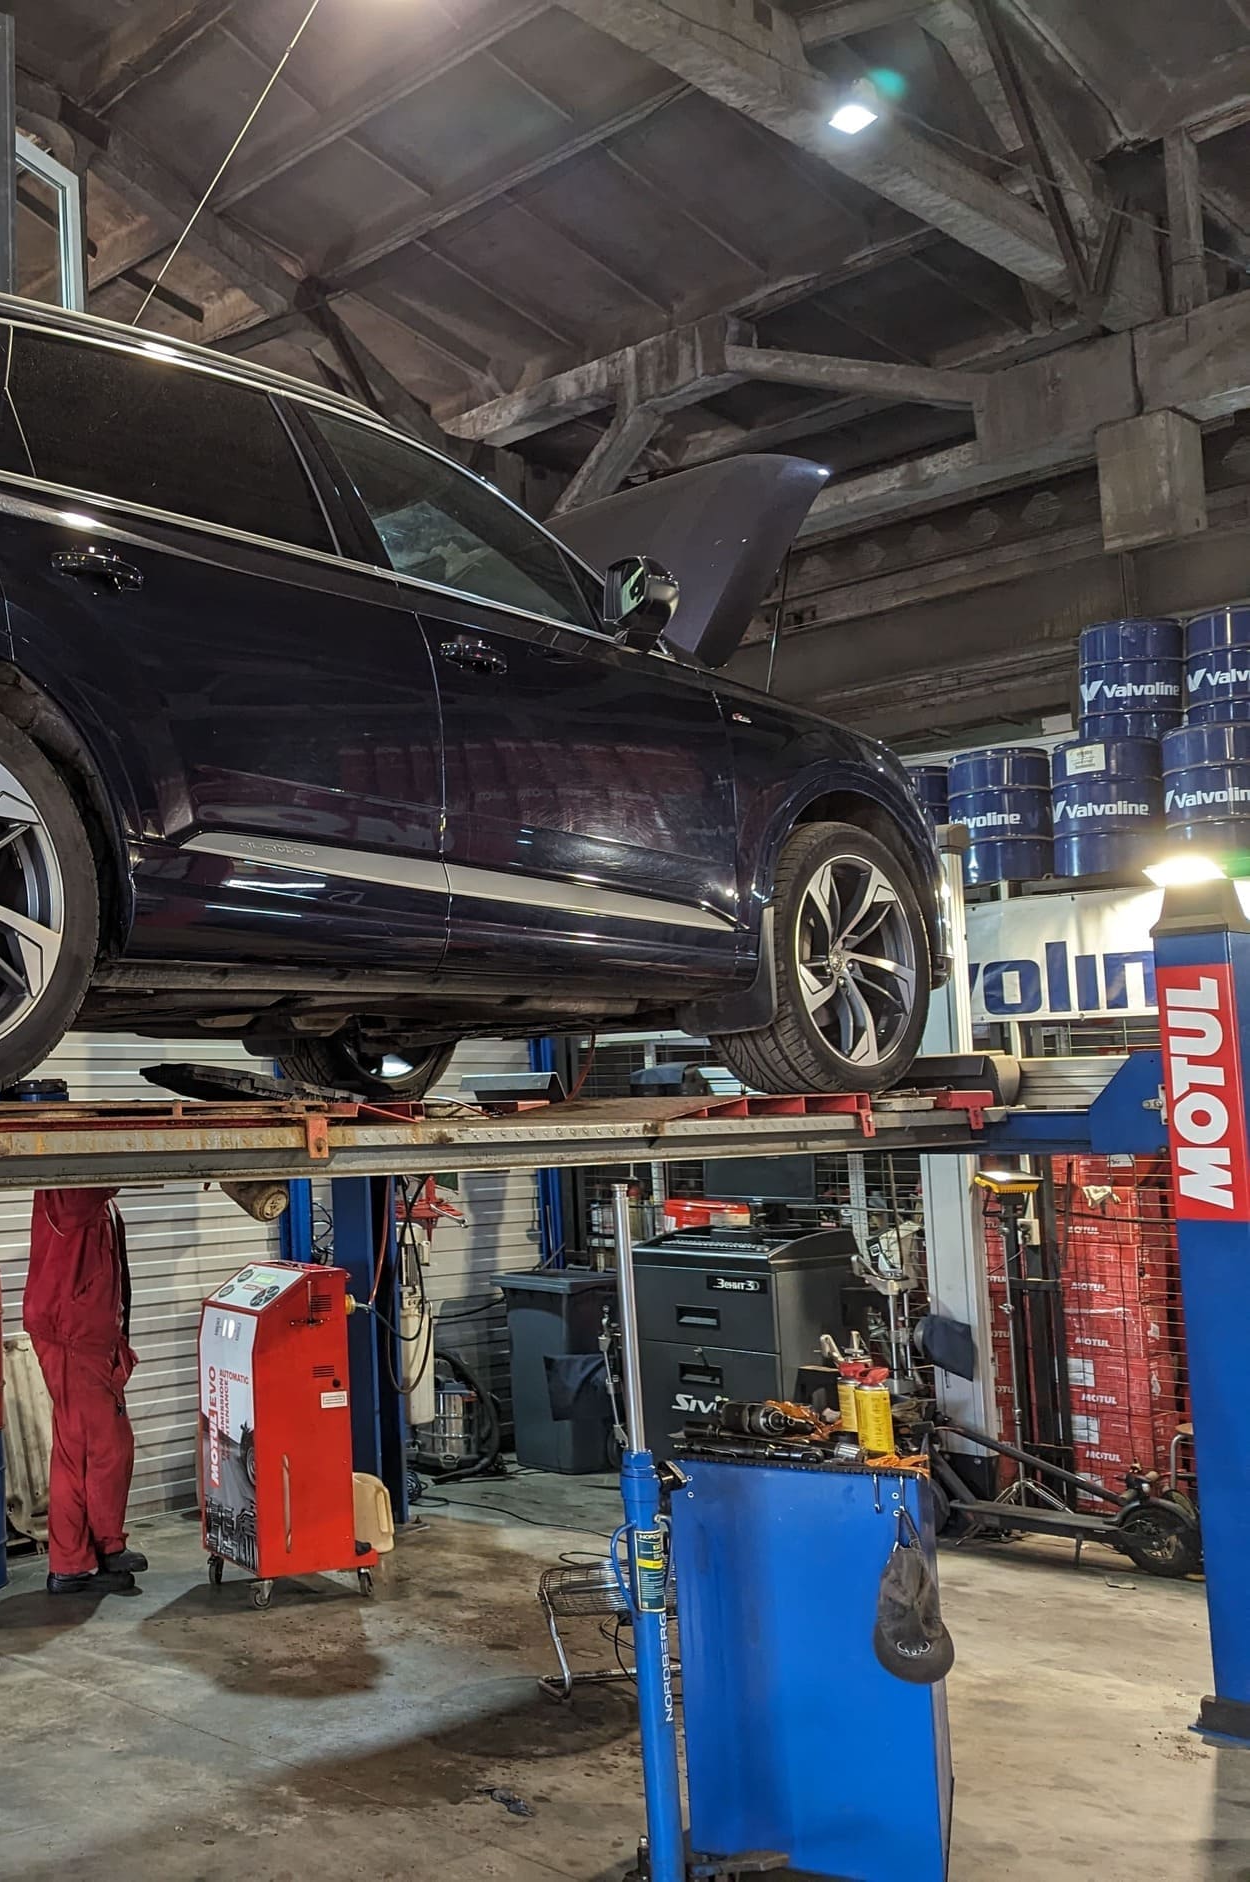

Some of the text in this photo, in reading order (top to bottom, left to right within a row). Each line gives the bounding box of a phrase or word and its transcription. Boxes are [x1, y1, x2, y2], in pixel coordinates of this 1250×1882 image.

[1103, 681, 1181, 698] Valvoline
[1066, 801, 1150, 818] Valvoline
[949, 811, 1022, 829] lvoline
[968, 941, 1158, 1015] olin
[1166, 976, 1234, 1209] MOTUL
[1075, 1337, 1110, 1347] MOTUL
[1081, 1394, 1117, 1405] MOTUL
[208, 1366, 220, 1487] MOTUL EVO
[1085, 1450, 1121, 1462] MOTUL
[659, 1612, 673, 1722] NORDBERG
